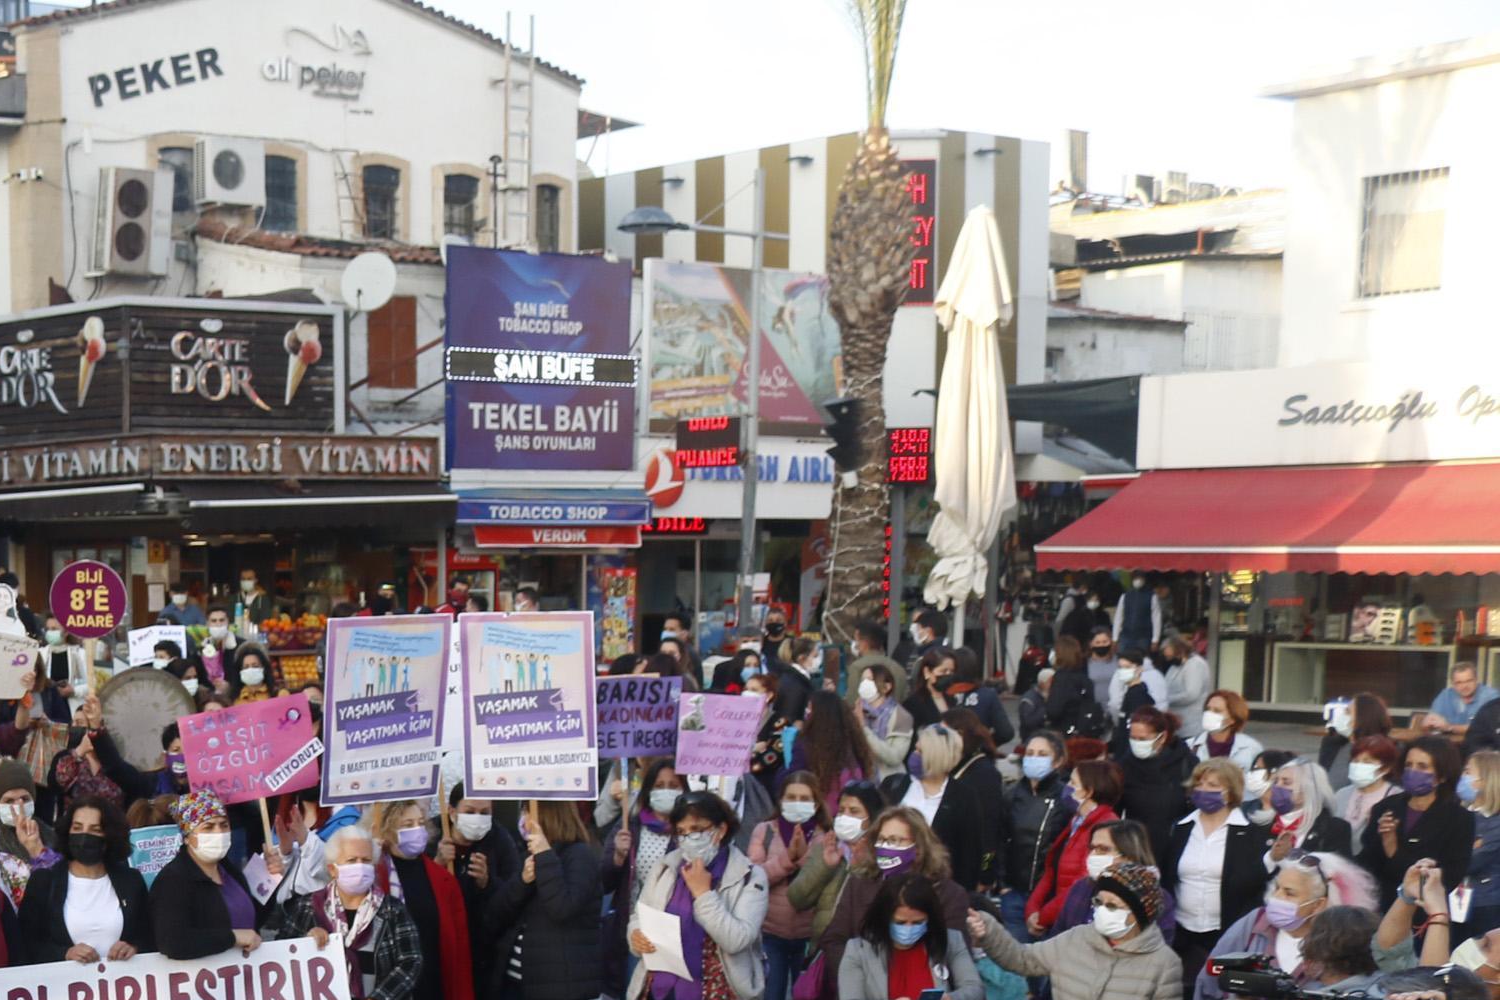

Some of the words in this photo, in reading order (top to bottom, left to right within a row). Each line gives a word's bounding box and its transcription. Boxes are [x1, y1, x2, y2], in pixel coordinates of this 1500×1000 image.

[88, 47, 224, 107] PEKER
[539, 301, 568, 319] BÜFE
[499, 317, 551, 333] TOBACCO
[553, 320, 583, 335] SHOP
[171, 331, 249, 361] CARTE
[494, 353, 537, 381] ŞAN
[542, 353, 595, 381] BÜFE
[468, 403, 548, 431] TEKEL
[495, 435, 530, 451] ŞANS
[532, 436, 596, 451] OYUNLARI
[24, 440, 141, 480] VİTAMİN
[161, 438, 283, 473] ENERJİ
[298, 438, 432, 474] VİTAMİN
[489, 505, 563, 520] TOBACCO
[567, 506, 608, 521] SHOP
[339, 699, 395, 720] YAŞAMAK
[477, 695, 538, 715] YAŞAMAK
[346, 722, 407, 745] YAŞATMAK
[409, 714, 431, 734] İÇİN
[488, 720, 553, 740] YAŞATMAK
[556, 715, 580, 732] İÇİN
